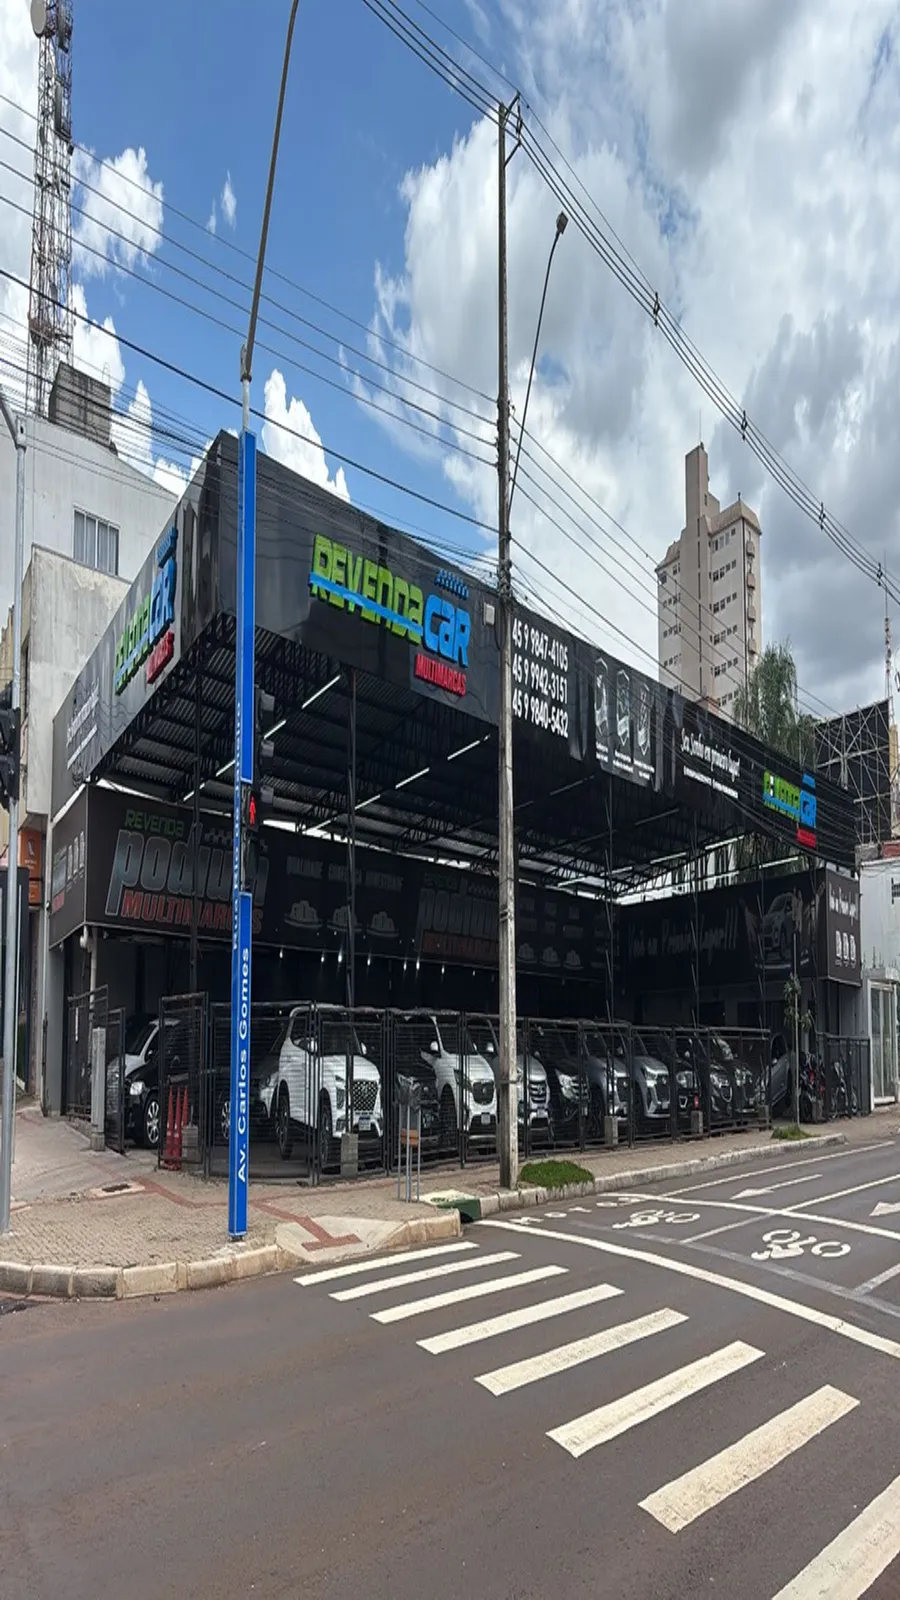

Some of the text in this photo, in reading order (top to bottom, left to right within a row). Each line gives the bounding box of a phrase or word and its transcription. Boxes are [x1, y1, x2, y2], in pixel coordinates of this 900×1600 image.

[512, 617, 569, 672] 45 9 9847-4105
[415, 653, 467, 697] MULTIMARCAS
[512, 652, 568, 704] 45 9 9942-3151
[512, 687, 569, 738] 45 9 9840-5432
[120, 888, 264, 934] MULTIMARCS
[238, 947, 249, 1183] Av. Carlos Gomes
